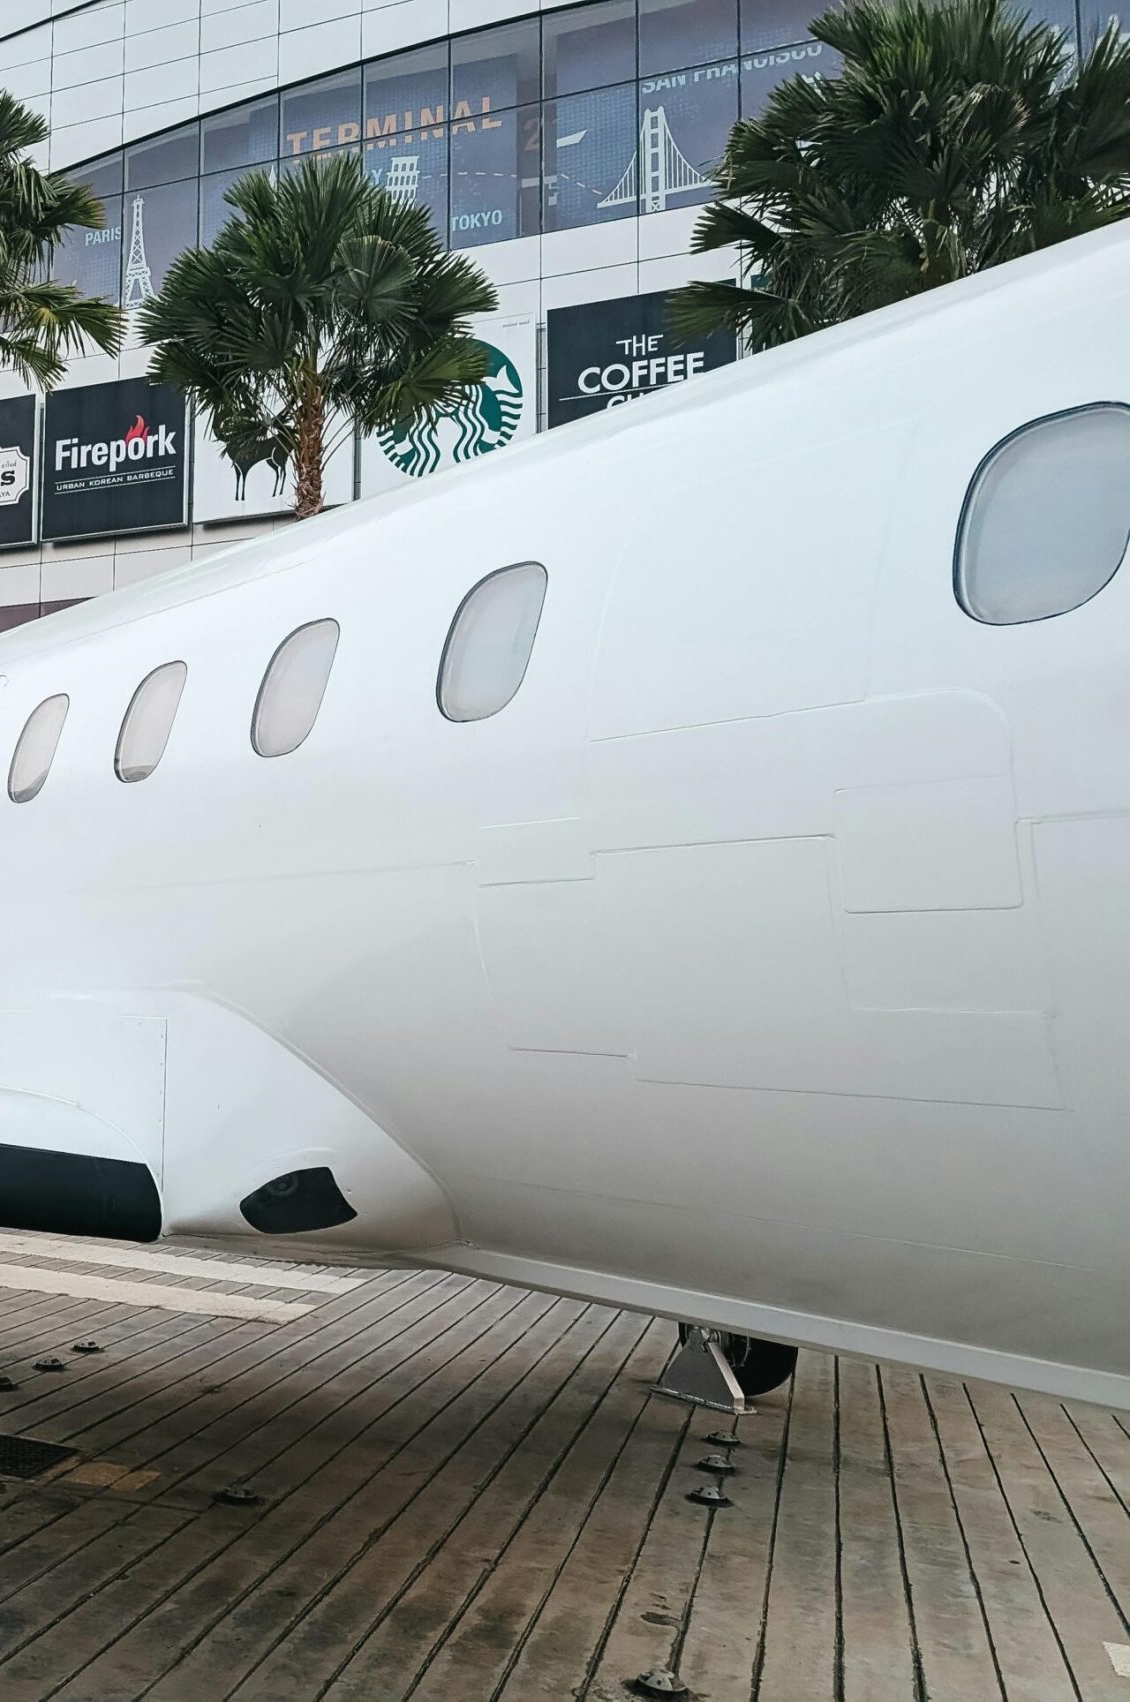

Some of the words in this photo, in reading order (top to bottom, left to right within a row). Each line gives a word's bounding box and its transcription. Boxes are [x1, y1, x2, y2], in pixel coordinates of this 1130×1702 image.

[286, 96, 503, 164] TERMINAL
[451, 209, 503, 232] TOKYO
[85, 226, 122, 247] PARIS
[615, 334, 664, 357] THE
[577, 351, 705, 394] COFFEE
[55, 424, 177, 472] Firepork
[56, 481, 86, 491] URBAN
[89, 476, 124, 487] KOREAN
[126, 469, 174, 482] BARBEQUE
